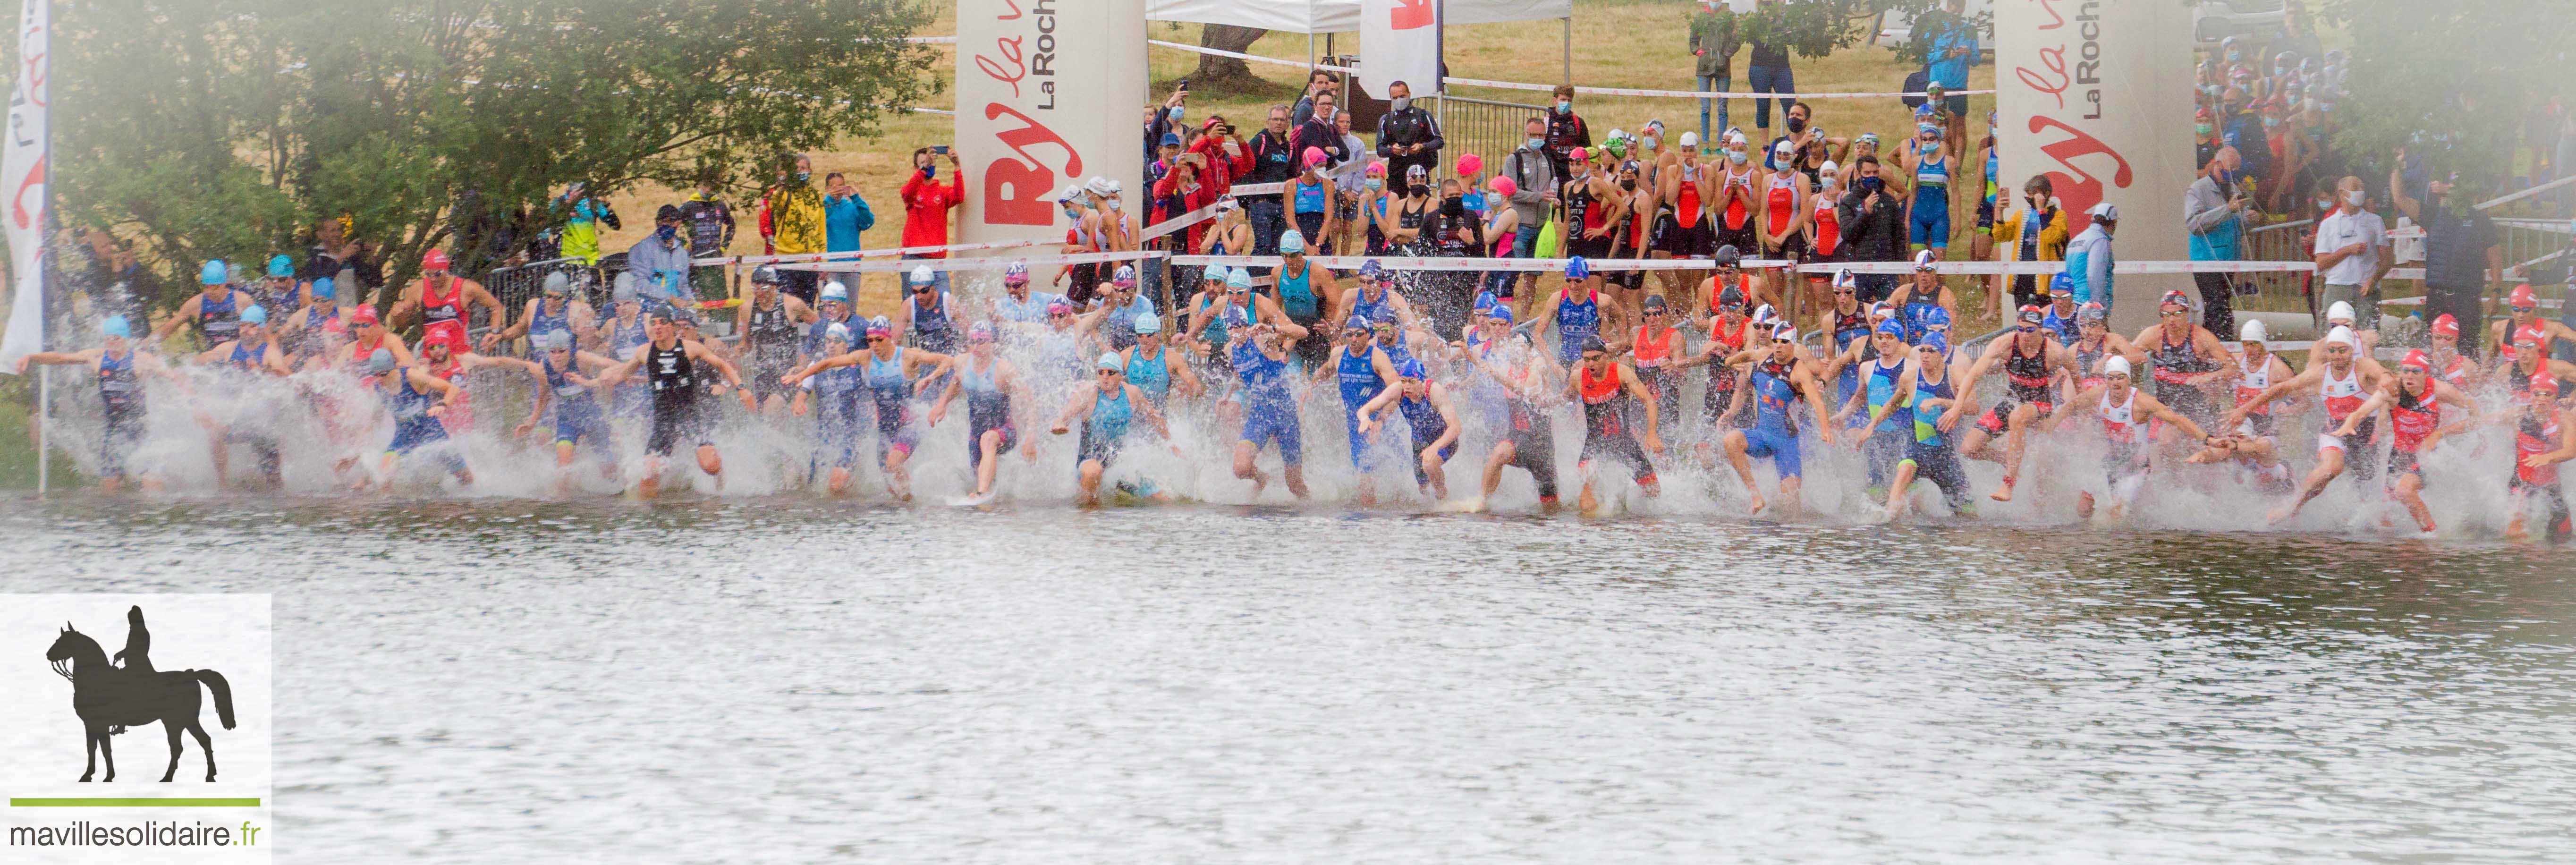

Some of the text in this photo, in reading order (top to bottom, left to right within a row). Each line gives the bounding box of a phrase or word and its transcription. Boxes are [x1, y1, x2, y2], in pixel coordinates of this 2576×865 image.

[975, 35, 1026, 98] la
[1038, 81, 1055, 110] La
[2017, 44, 2069, 109] la
[2083, 89, 2101, 119] La
[984, 102, 1083, 226] Ry
